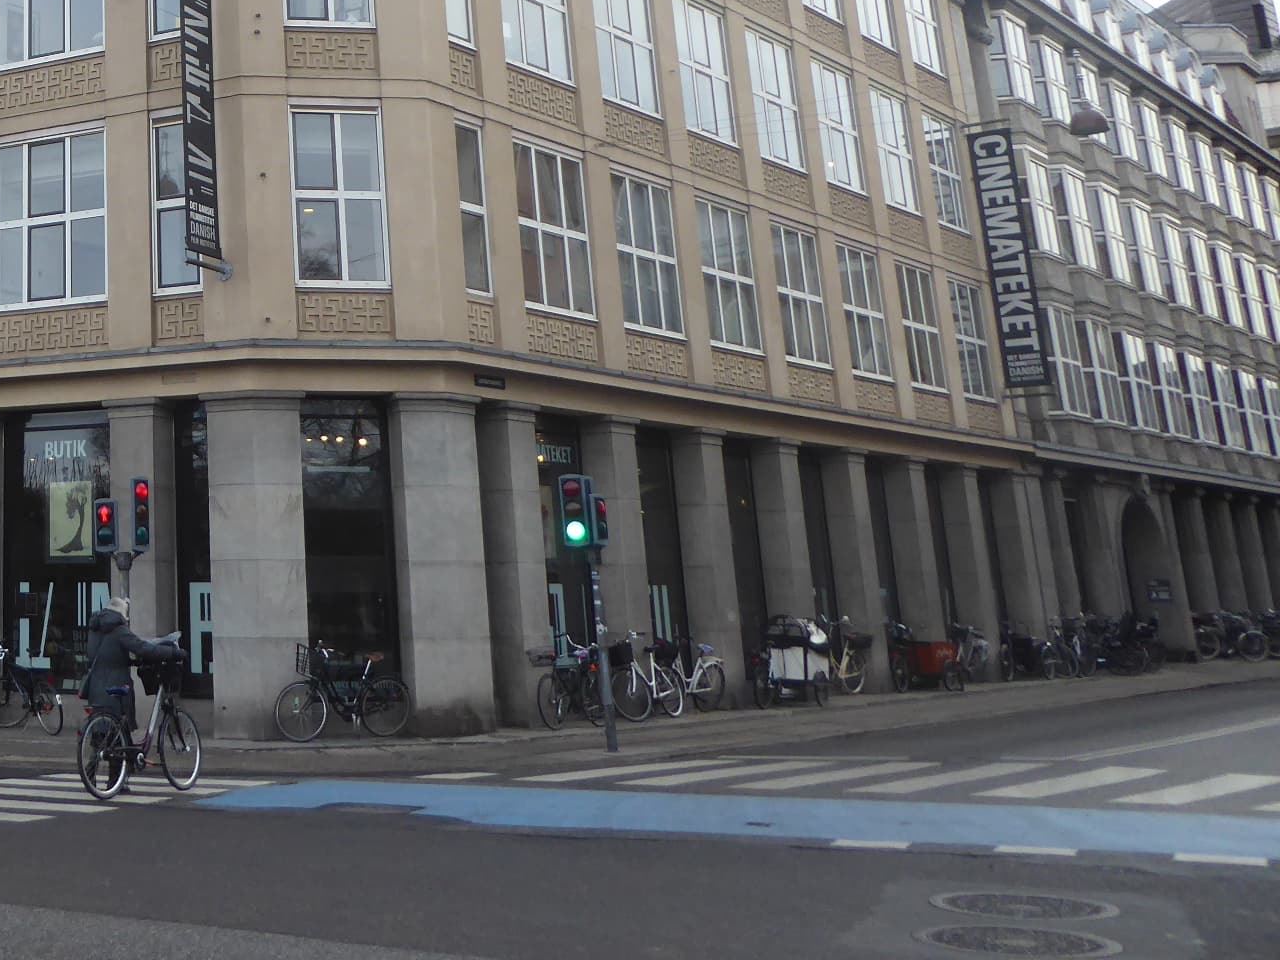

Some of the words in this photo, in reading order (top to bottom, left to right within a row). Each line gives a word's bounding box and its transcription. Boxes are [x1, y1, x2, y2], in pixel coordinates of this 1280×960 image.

[190, 221, 216, 241] DANISH
[973, 133, 1041, 352] CINEMATEKET
[45, 439, 86, 458] BUTIK
[536, 444, 572, 464] ATEKET
